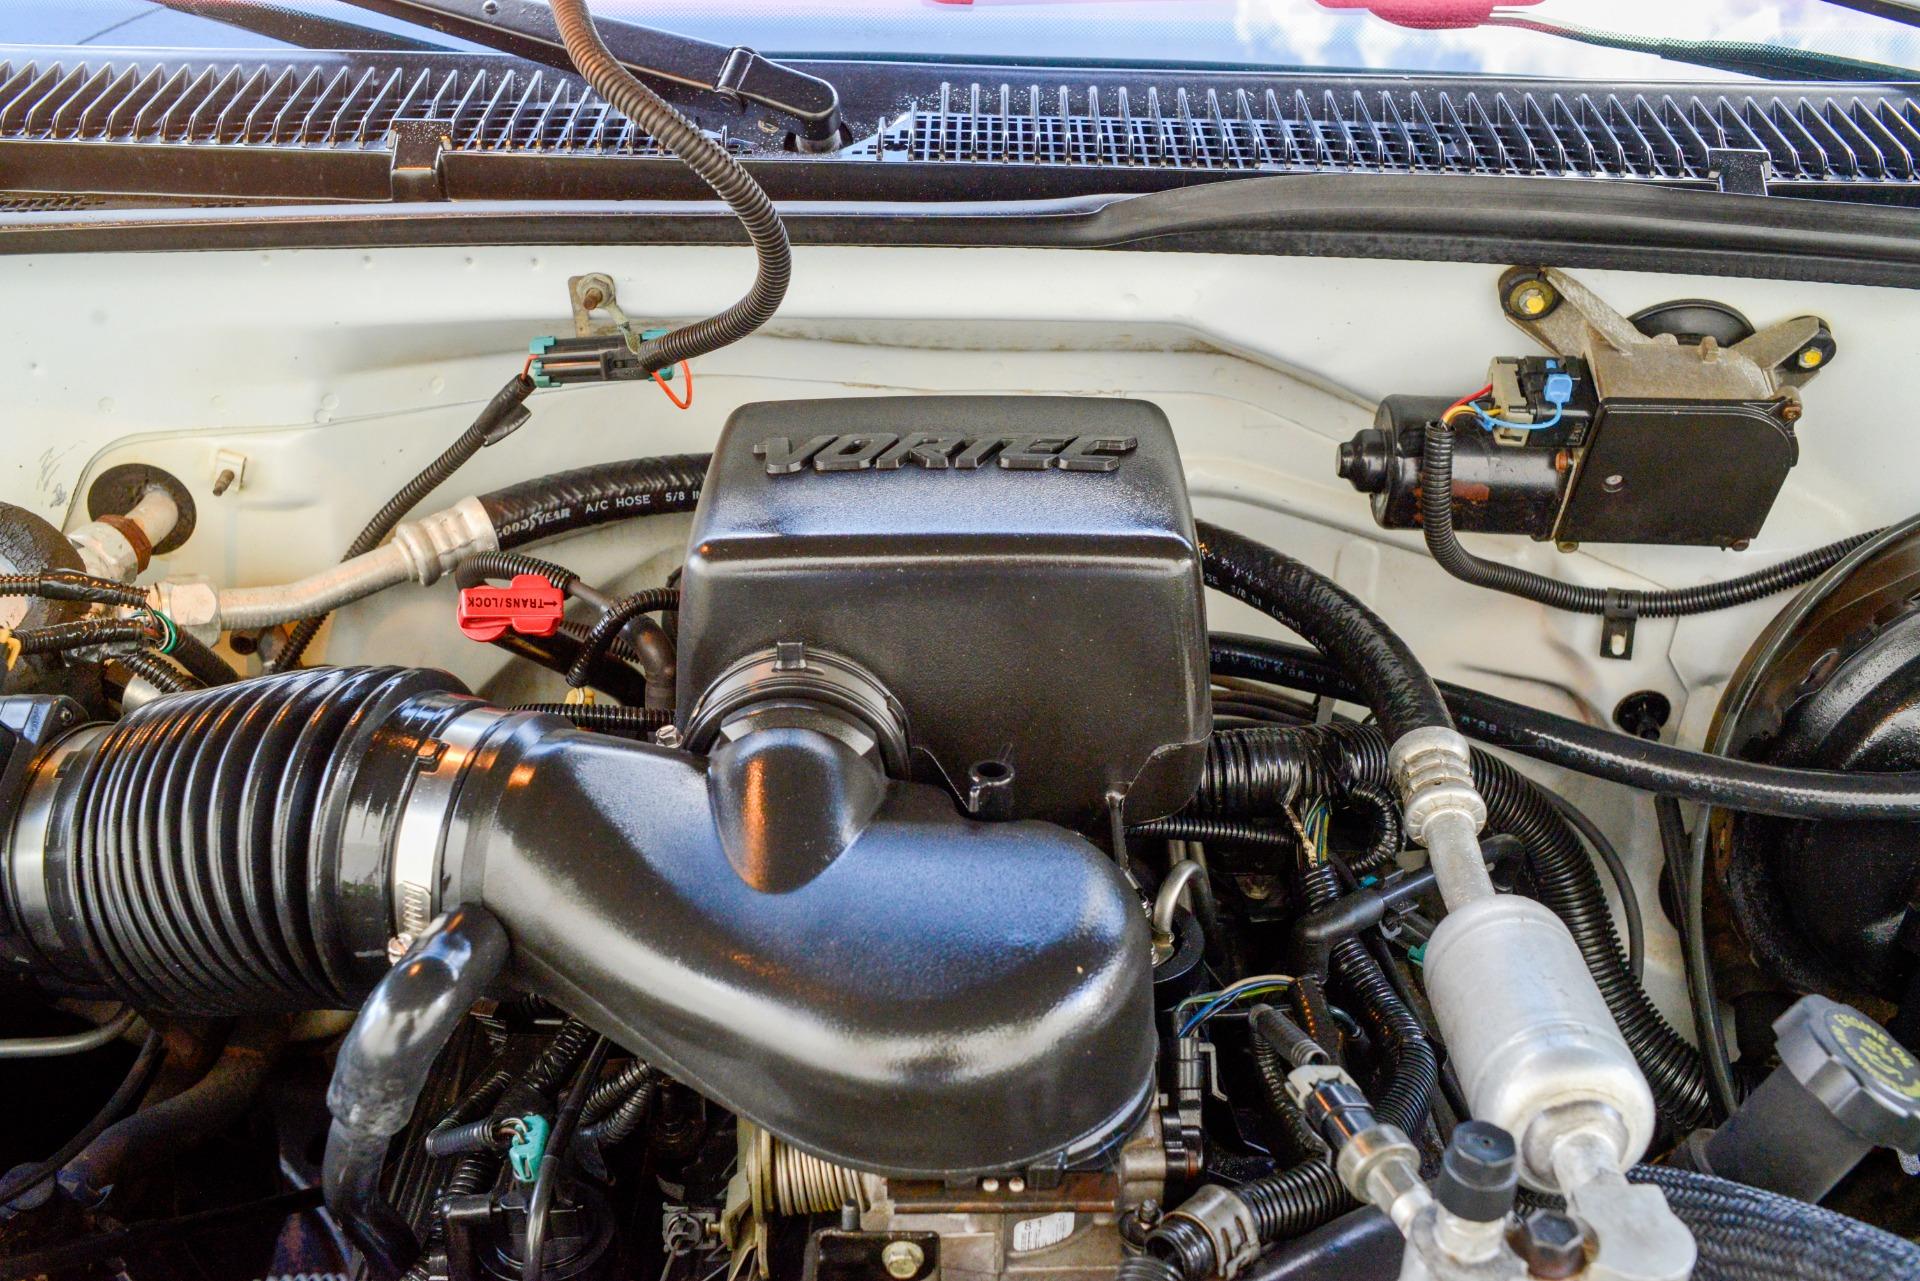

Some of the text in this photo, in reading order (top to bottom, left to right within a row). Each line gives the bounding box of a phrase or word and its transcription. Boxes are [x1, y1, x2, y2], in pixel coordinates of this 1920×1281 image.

[753, 432, 1138, 474] VORTEC
[585, 500, 609, 514] A/C
[616, 494, 651, 508] HOSE
[665, 490, 685, 502] 5/8
[467, 596, 545, 609] TRANS/LOCK
